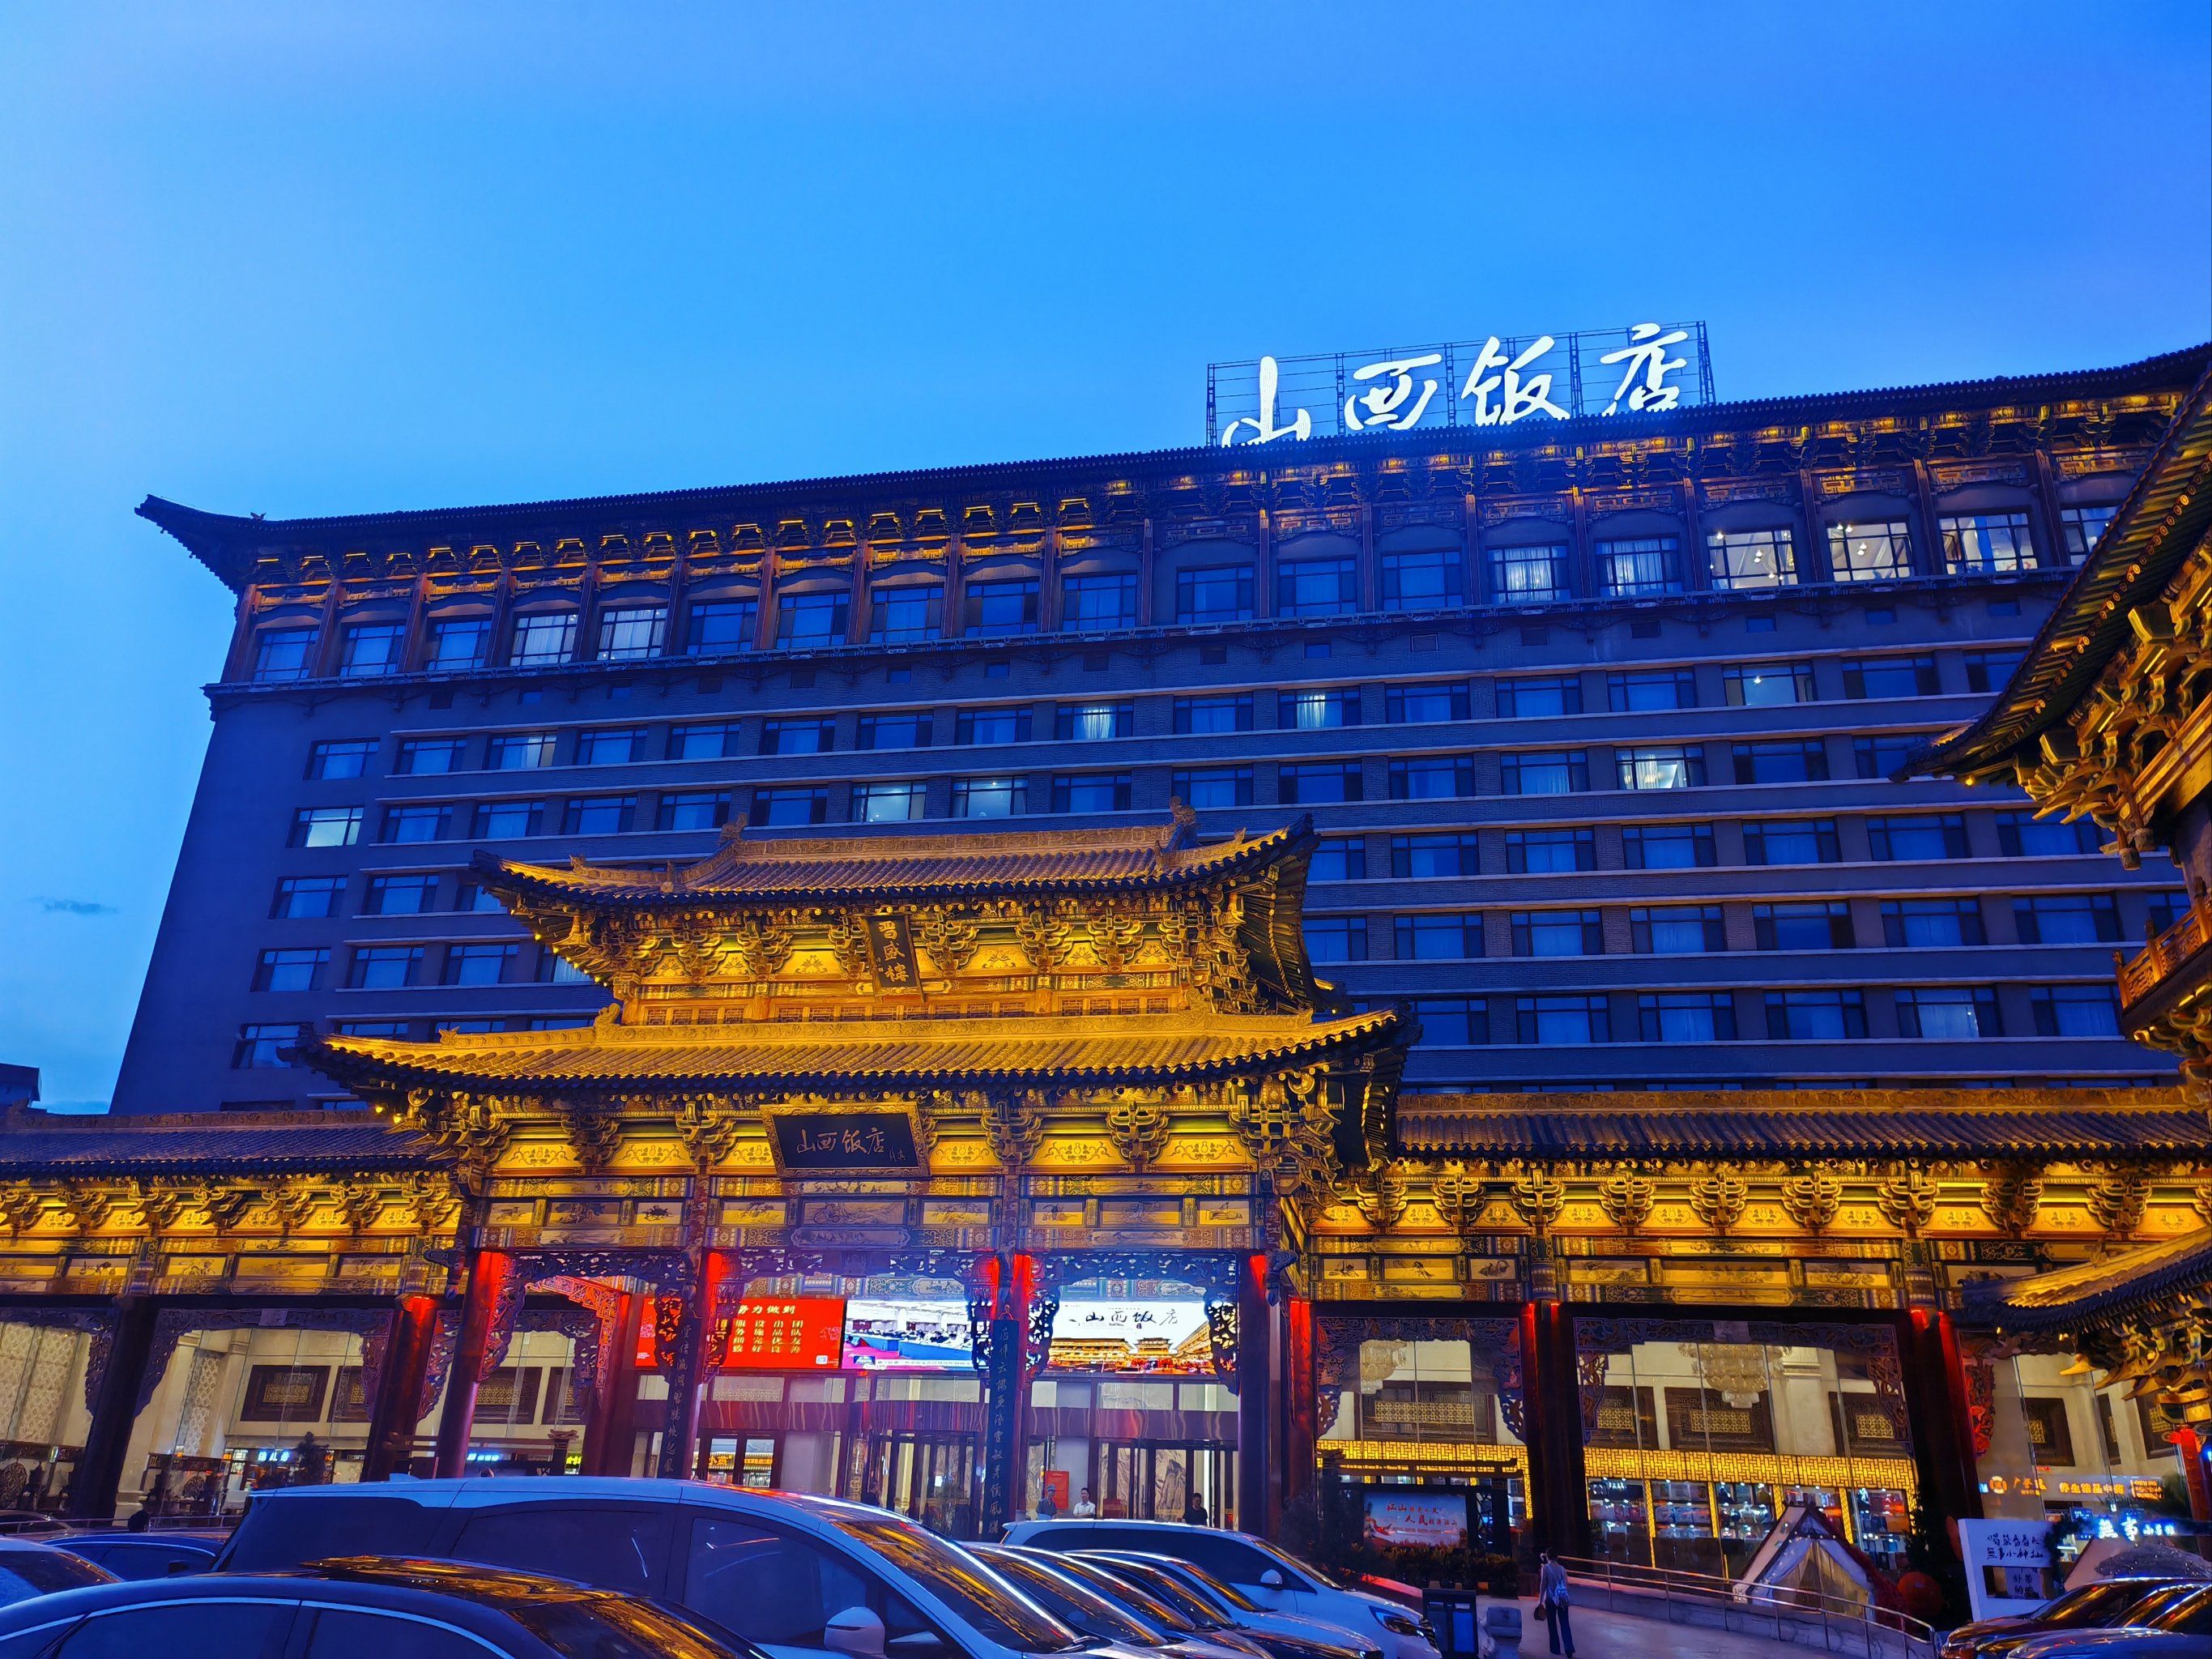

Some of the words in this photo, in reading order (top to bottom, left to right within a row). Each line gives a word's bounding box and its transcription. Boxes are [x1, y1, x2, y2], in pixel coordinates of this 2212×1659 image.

[1221, 322, 1690, 447] 山西饭店
[796, 1127, 885, 1154] 山西饭店
[1085, 1308, 1178, 1326] 山西饭店
